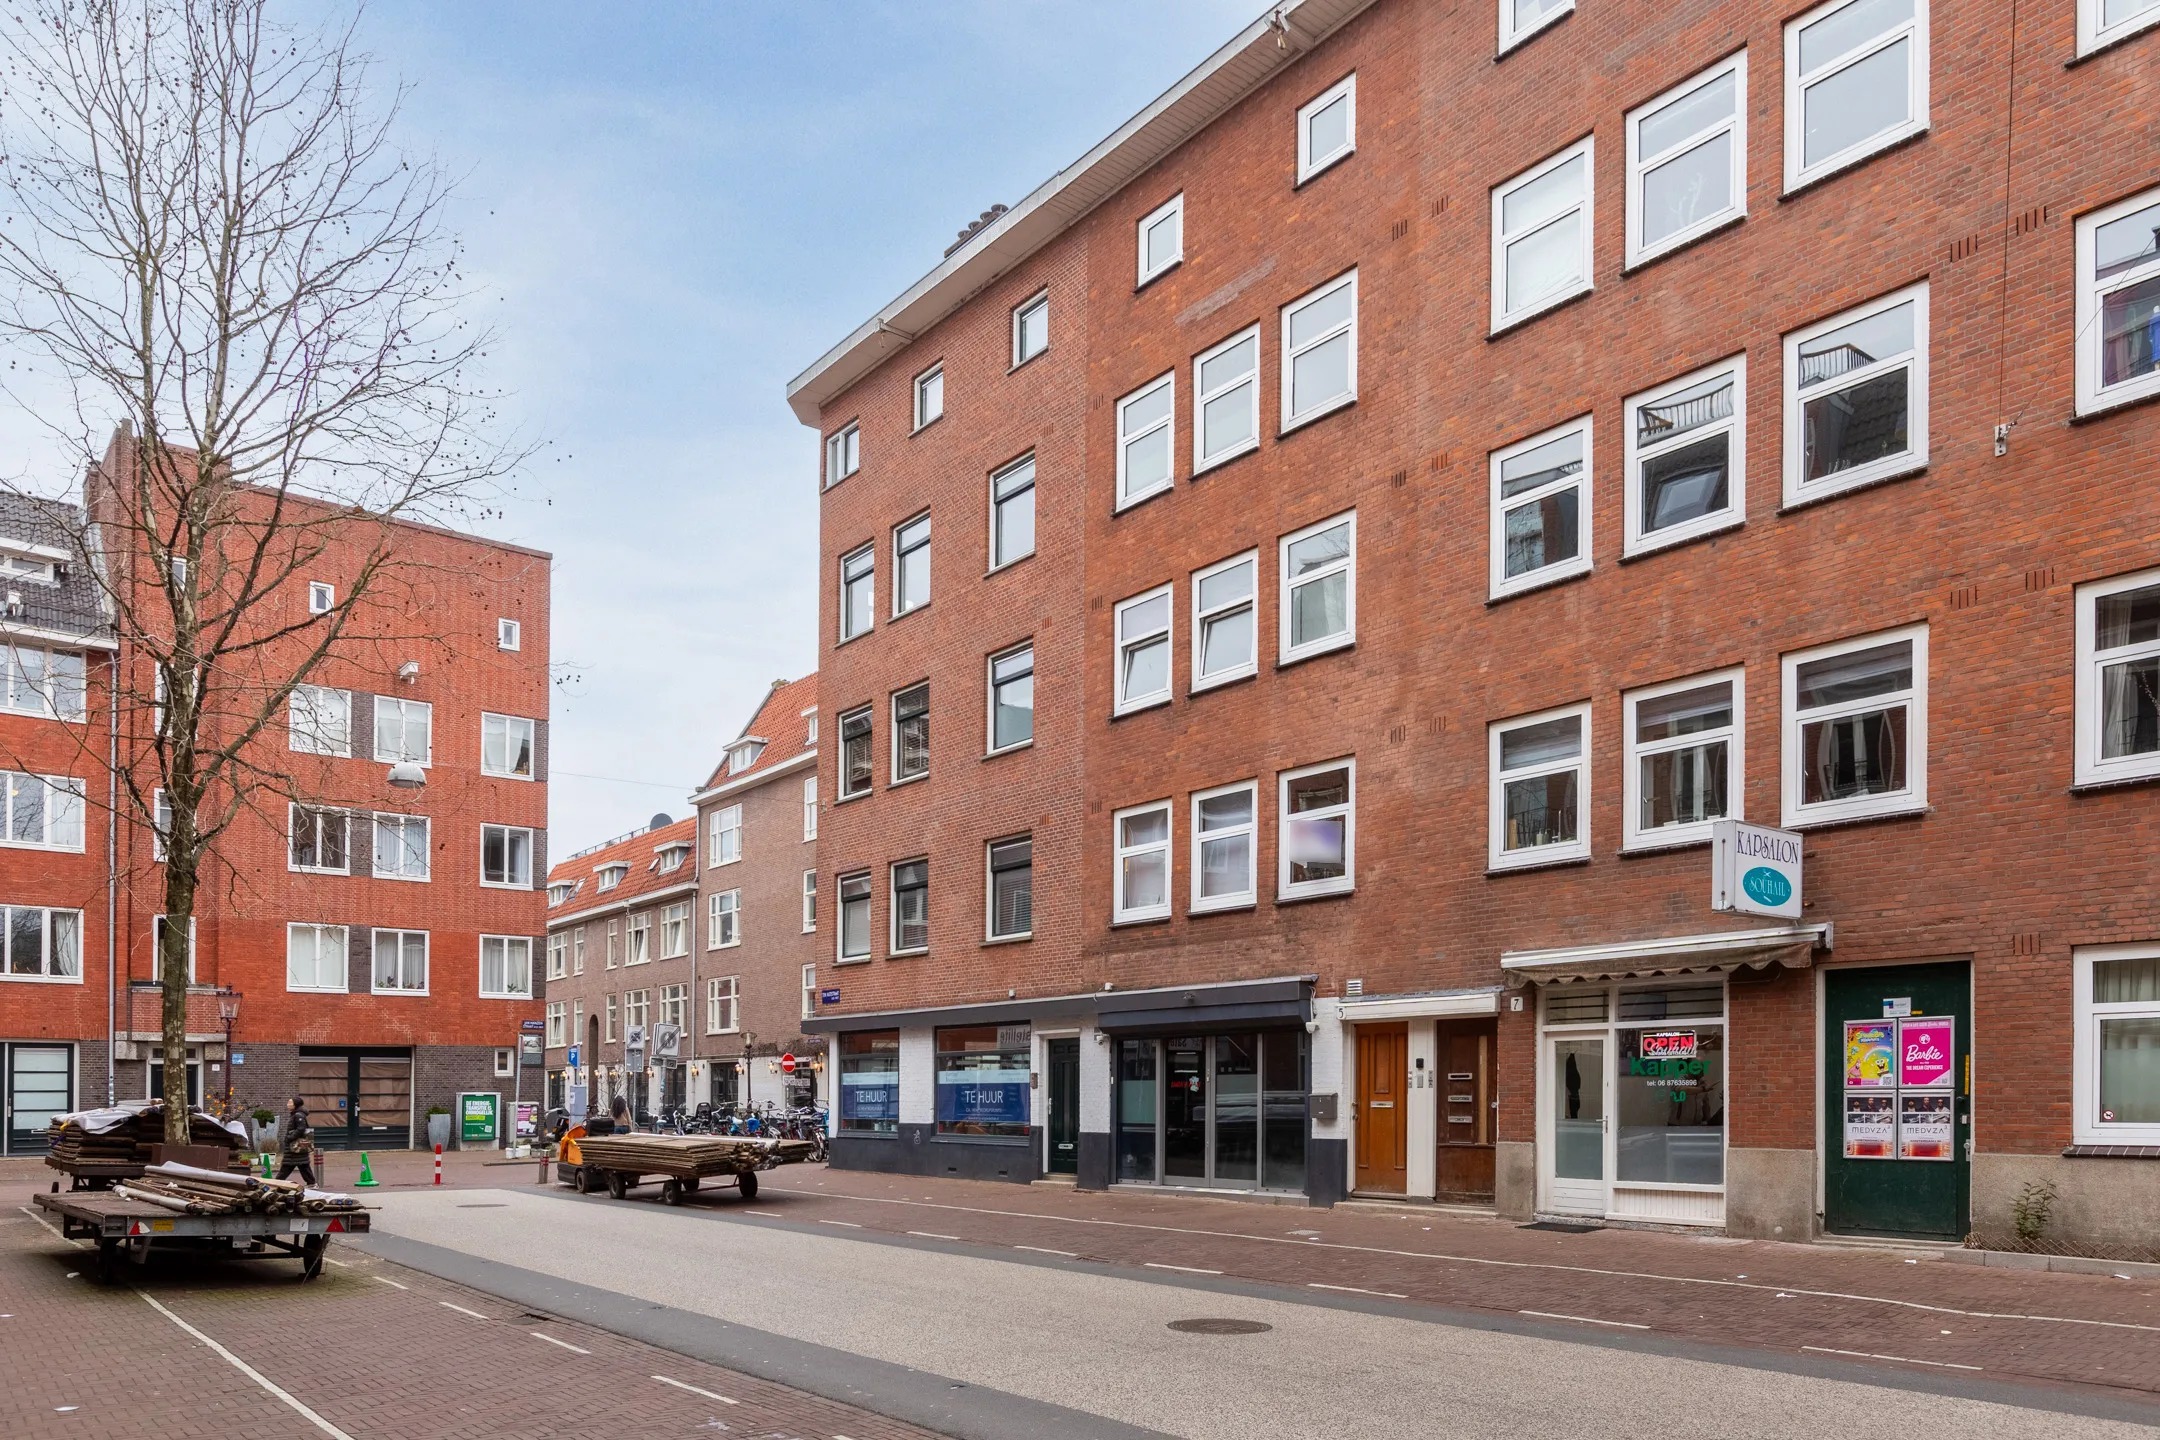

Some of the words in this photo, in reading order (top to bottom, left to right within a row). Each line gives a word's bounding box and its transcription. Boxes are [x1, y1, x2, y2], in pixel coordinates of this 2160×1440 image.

[1737, 831, 1799, 864] KAPSALON
[1749, 877, 1786, 897] SOUHAIL
[1514, 998, 1520, 1010] 7
[1338, 1007, 1344, 1019] 5
[1905, 1044, 1944, 1062] Barbie
[1630, 1057, 1713, 1079] Kapper
[856, 1090, 865, 1103] TE
[866, 1090, 888, 1103] HUUR
[965, 1090, 976, 1104] TE
[978, 1090, 1004, 1104] HUUR
